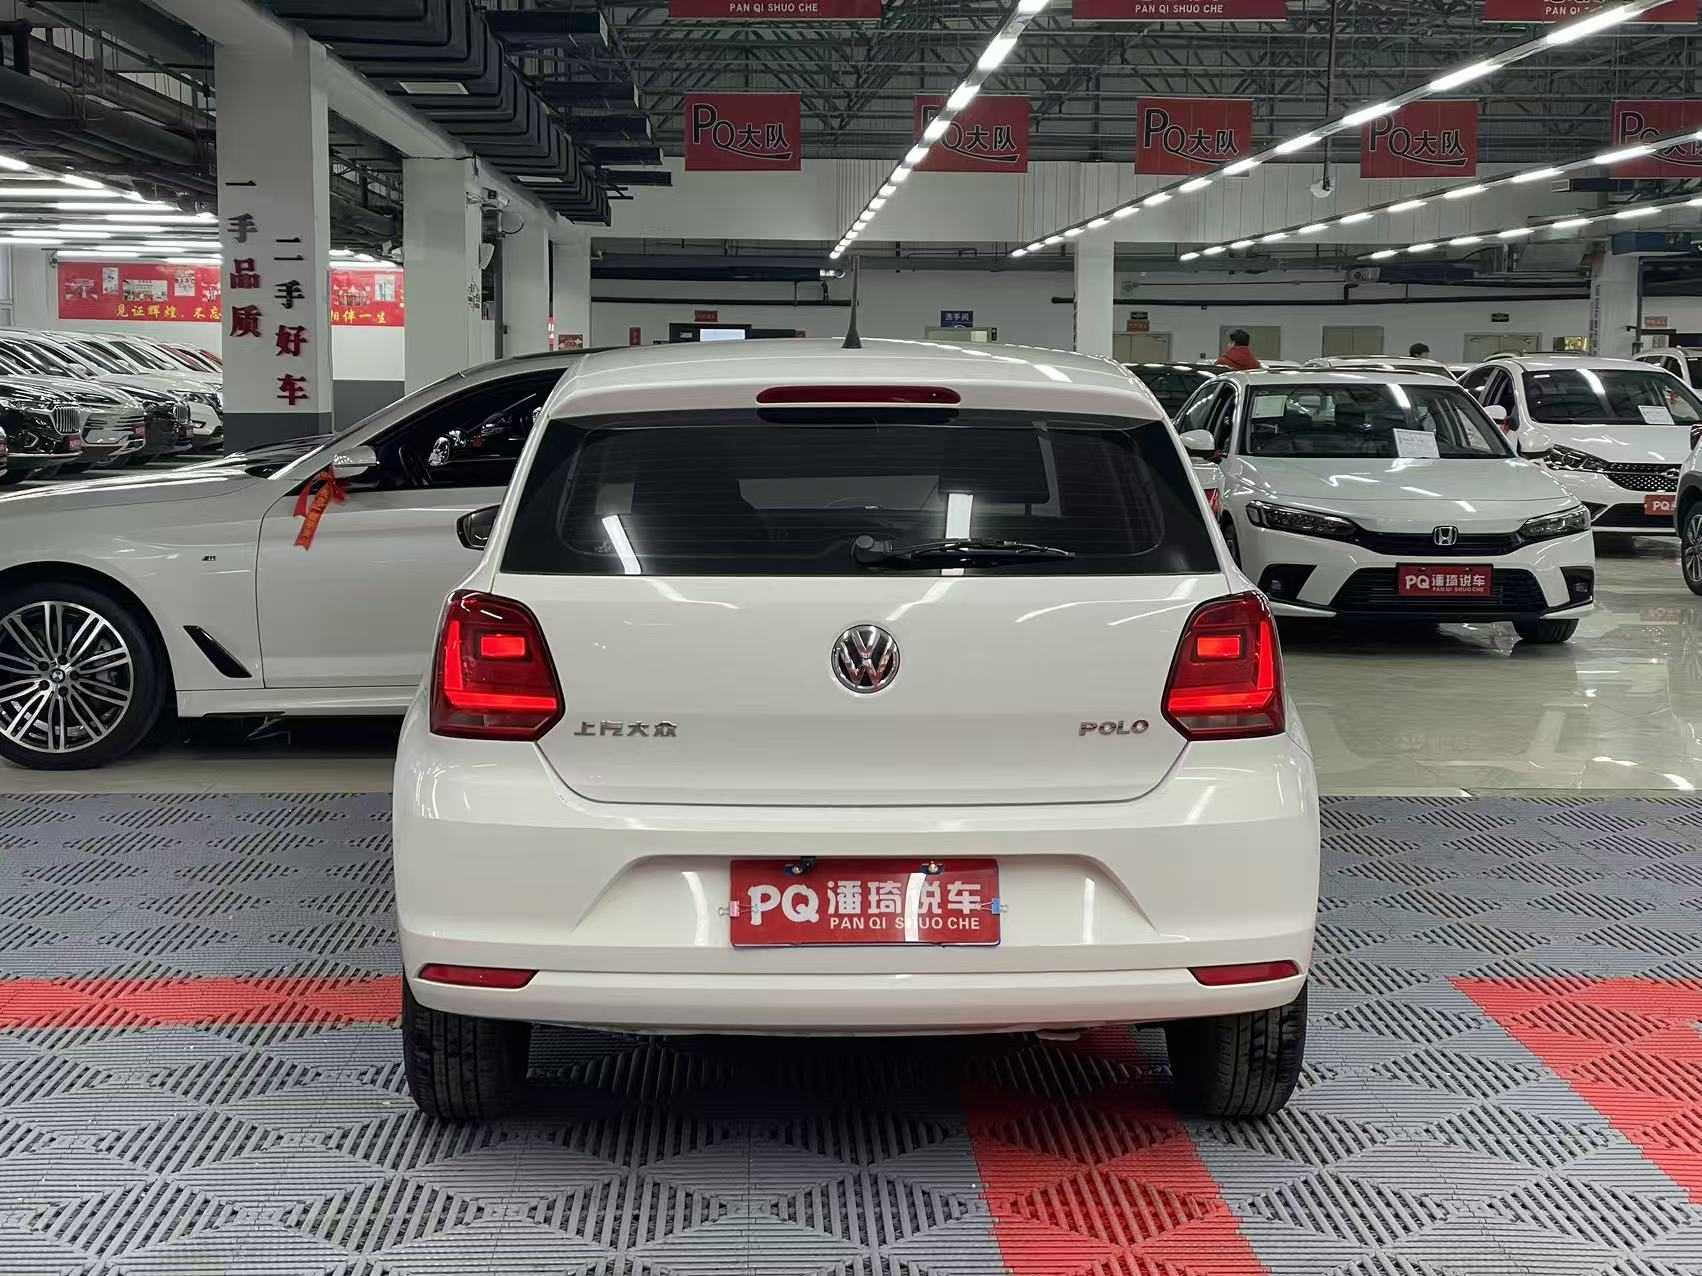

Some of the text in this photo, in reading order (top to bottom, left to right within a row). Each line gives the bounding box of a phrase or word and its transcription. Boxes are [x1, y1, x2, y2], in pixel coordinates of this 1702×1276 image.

[729, 3, 818, 13] PAN QI SHUO CHE
[1135, 4, 1224, 14] PAN QI SHUO CHE
[1545, 6, 1566, 15] PAN
[225, 180, 262, 338] 一手品质
[273, 237, 309, 406] 二手好车
[1653, 501, 1670, 512] PQ
[1405, 575, 1430, 589] PQ
[573, 720, 678, 738] 上汽大众
[1079, 719, 1149, 737] POLO
[747, 884, 820, 926] PQ
[830, 917, 980, 930] PAN QI SUO CHE
